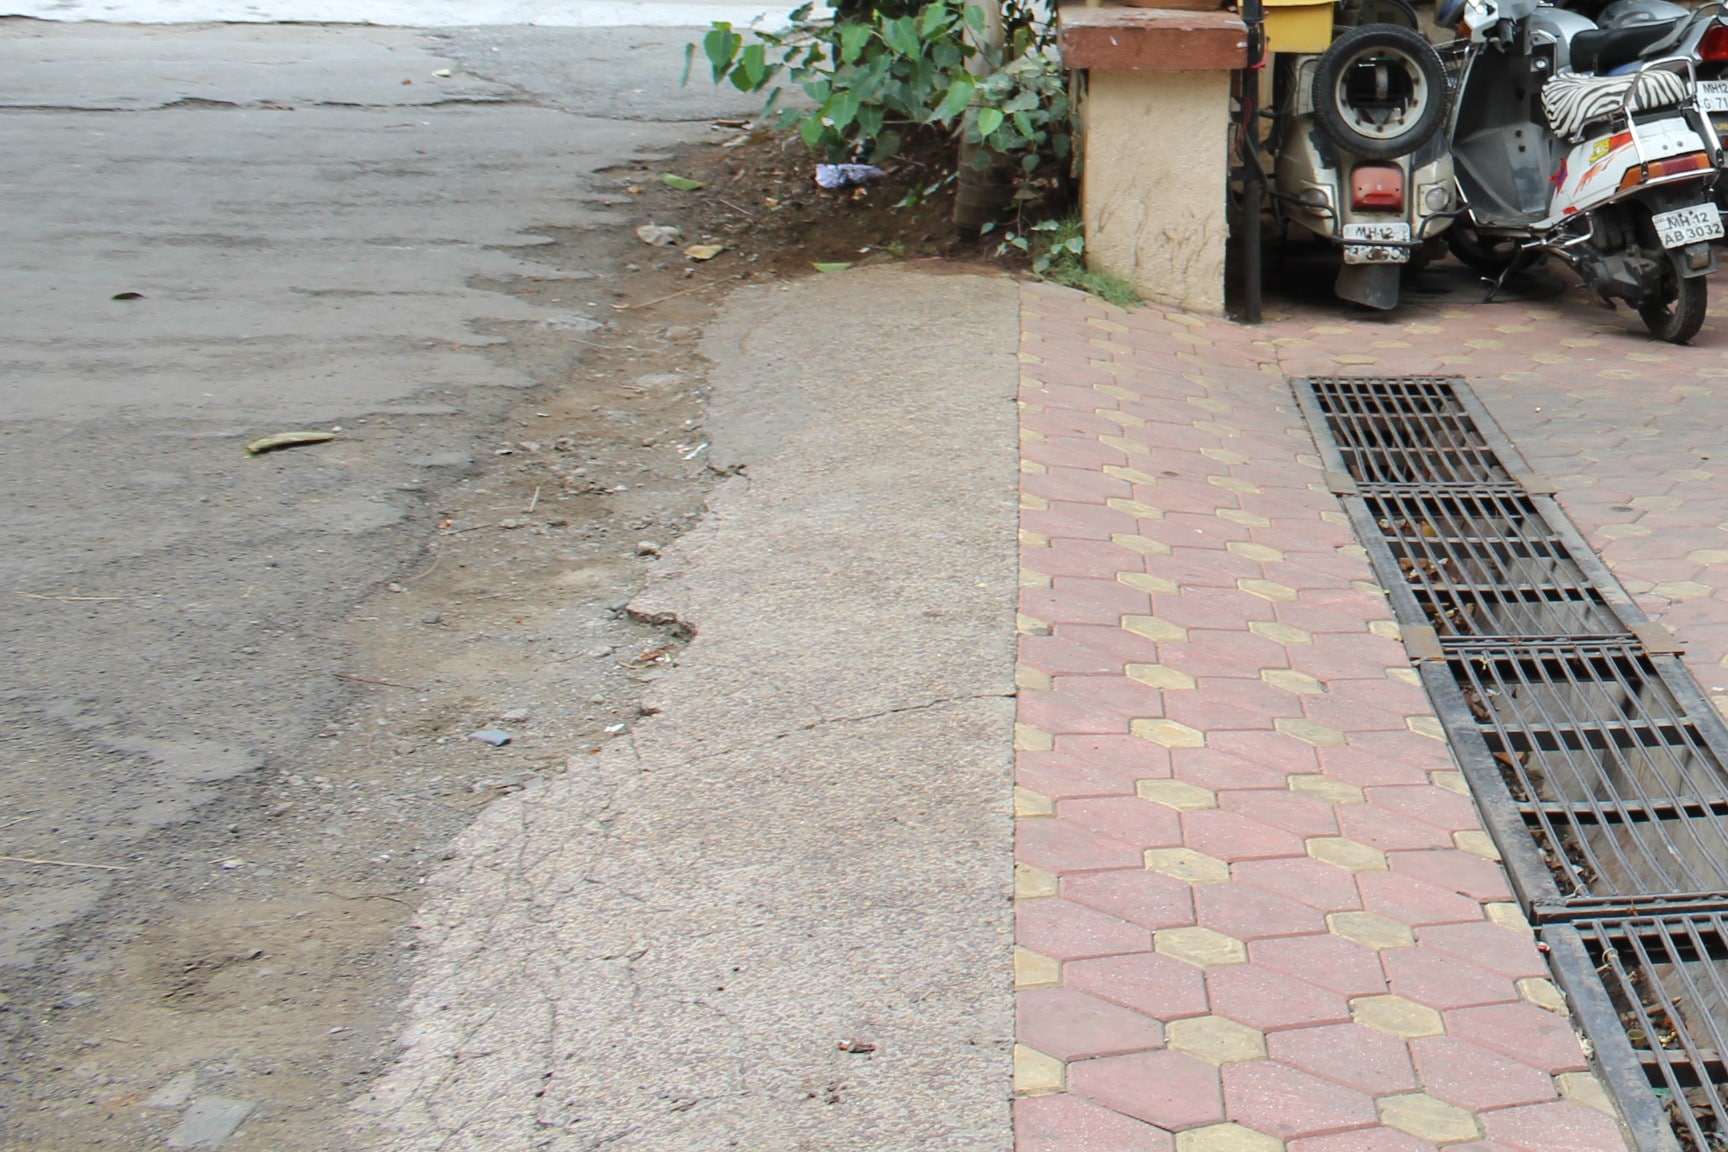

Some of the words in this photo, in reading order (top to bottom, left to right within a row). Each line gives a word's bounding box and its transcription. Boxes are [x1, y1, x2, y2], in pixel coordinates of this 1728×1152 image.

[1666, 214, 1692, 230] MH
[1693, 212, 1710, 225] 12
[1665, 230, 1685, 246] AB
[1686, 223, 1723, 239] 3032
